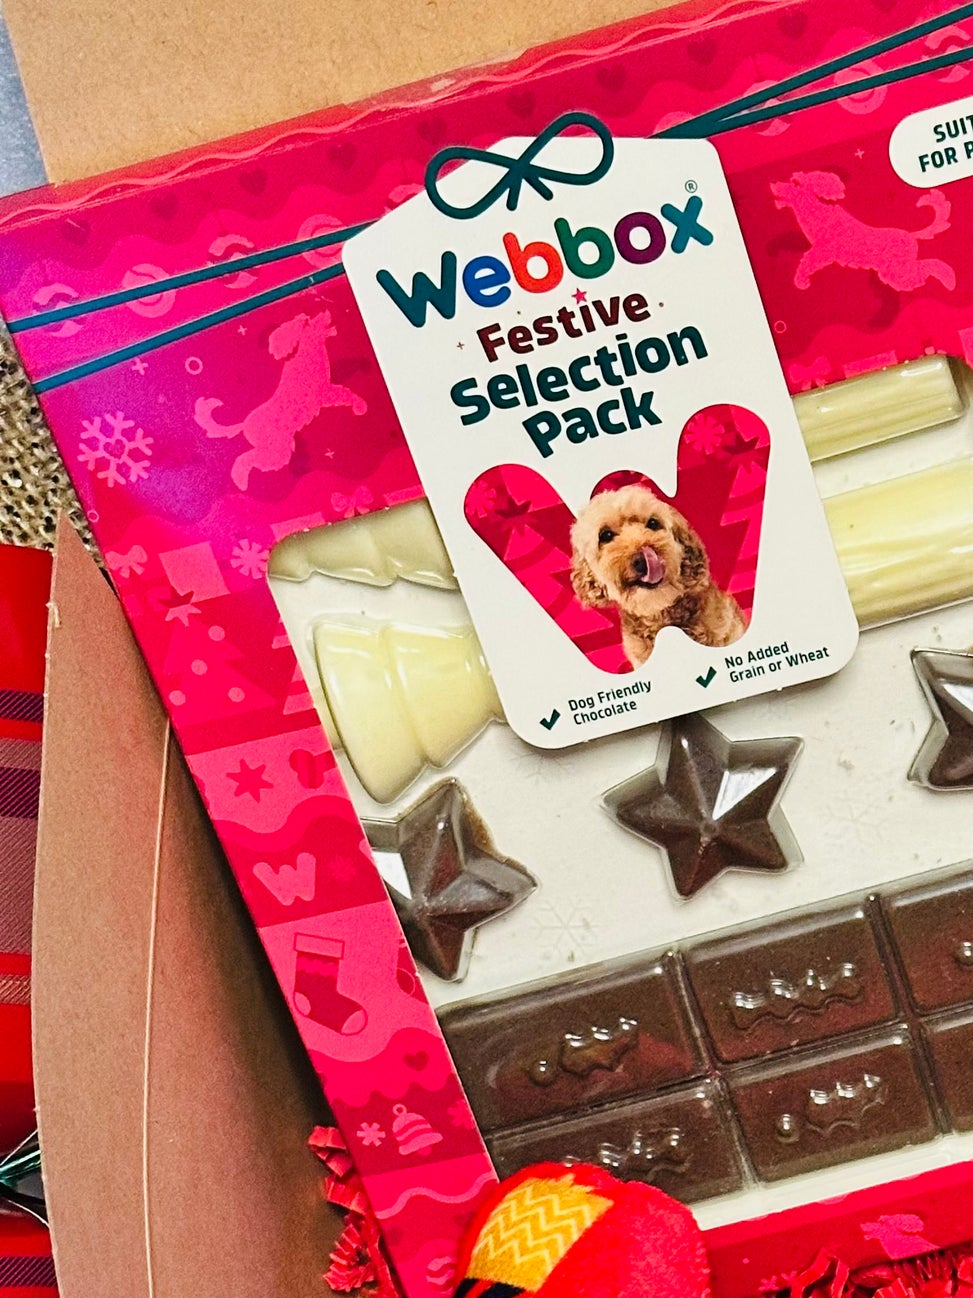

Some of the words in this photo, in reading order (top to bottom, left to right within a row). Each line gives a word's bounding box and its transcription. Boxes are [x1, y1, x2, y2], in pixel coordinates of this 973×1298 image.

[918, 147, 958, 172] FOR
[376, 195, 714, 328] Webbox
[477, 293, 650, 363] Festive
[450, 325, 708, 426] Selection
[522, 387, 662, 459] Pack
[724, 655, 743, 670] No
[747, 641, 790, 664] Added
[729, 663, 766, 684] Grain
[769, 660, 784, 673] or
[785, 646, 830, 668] Wheat
[568, 696, 595, 712] Dog
[598, 680, 652, 704] Friendly
[573, 699, 638, 726] Chocolate
